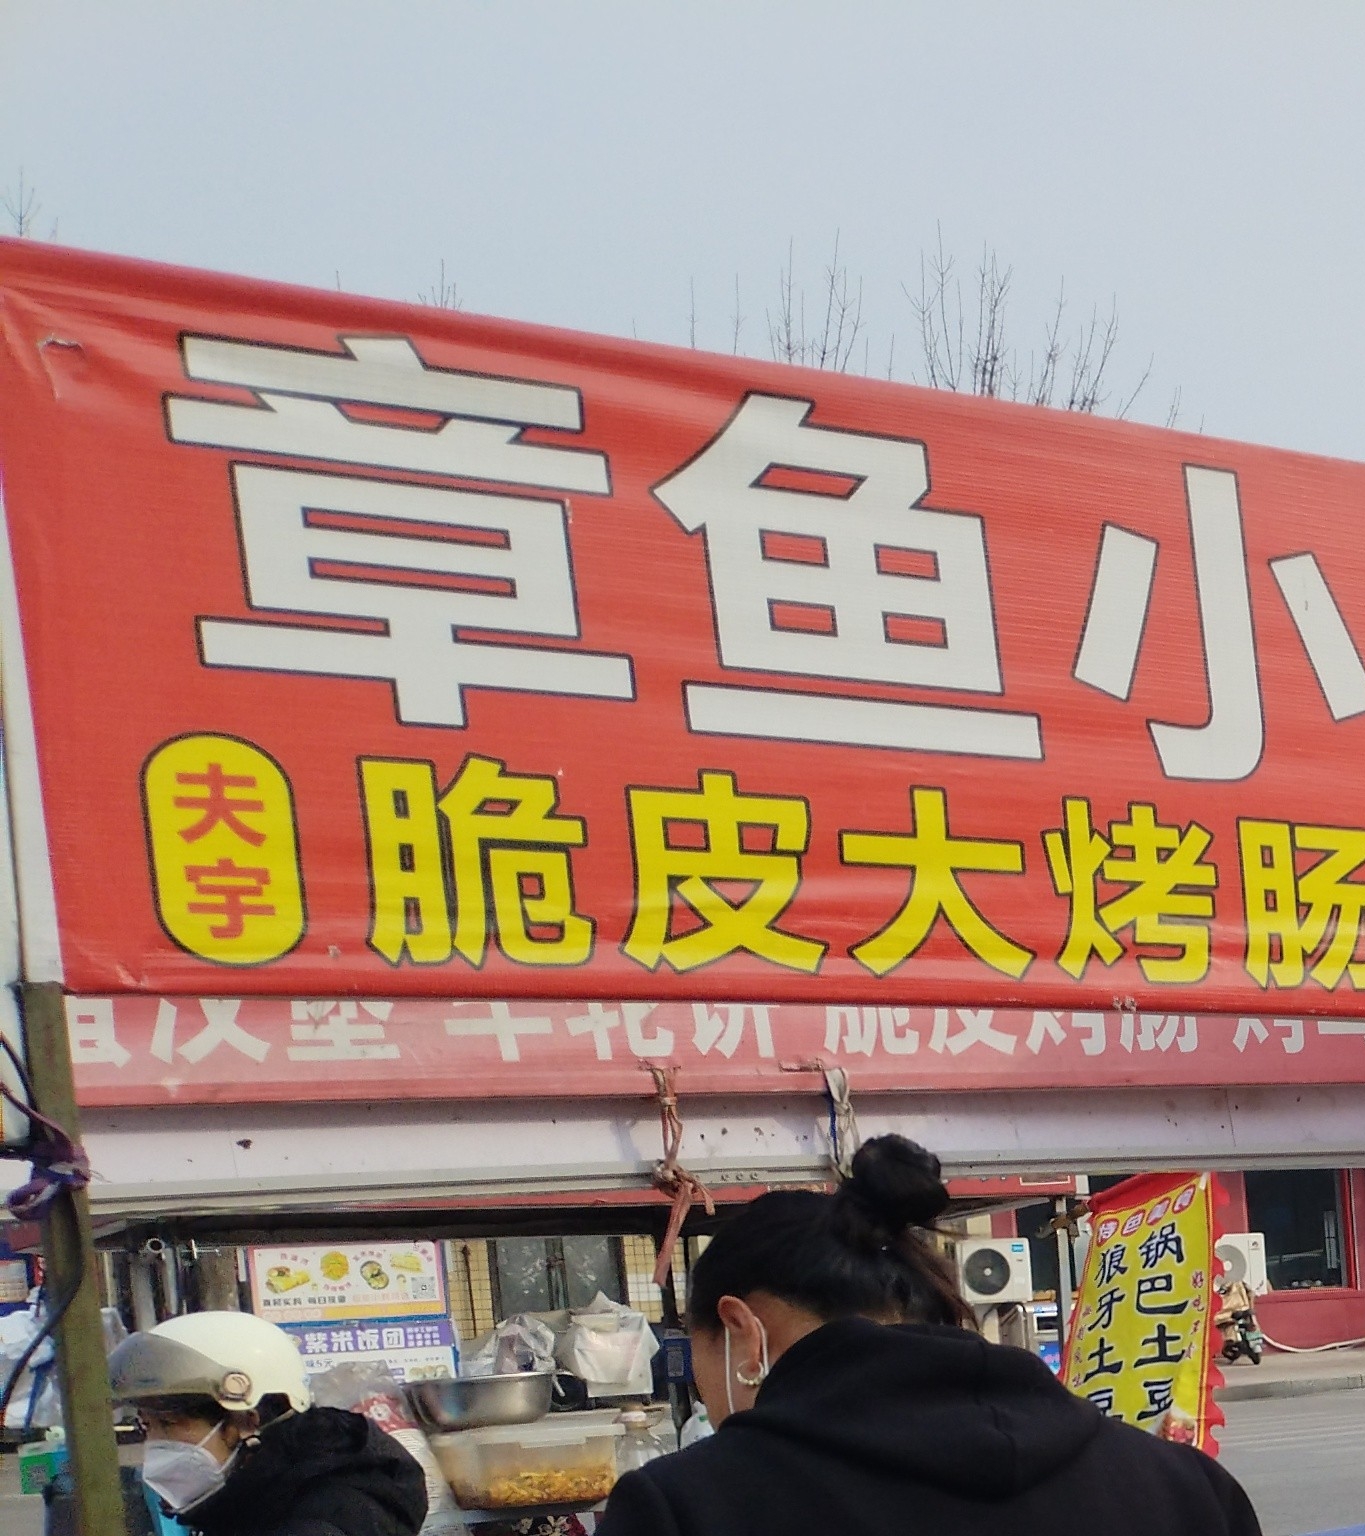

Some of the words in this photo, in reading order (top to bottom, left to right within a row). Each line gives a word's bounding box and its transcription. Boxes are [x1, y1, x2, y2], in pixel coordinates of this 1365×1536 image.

[173, 763, 276, 941] 夫宇
[304, 1328, 405, 1354] 紫米饭团
[1134, 1222, 1189, 1422] 锅巴土豆
